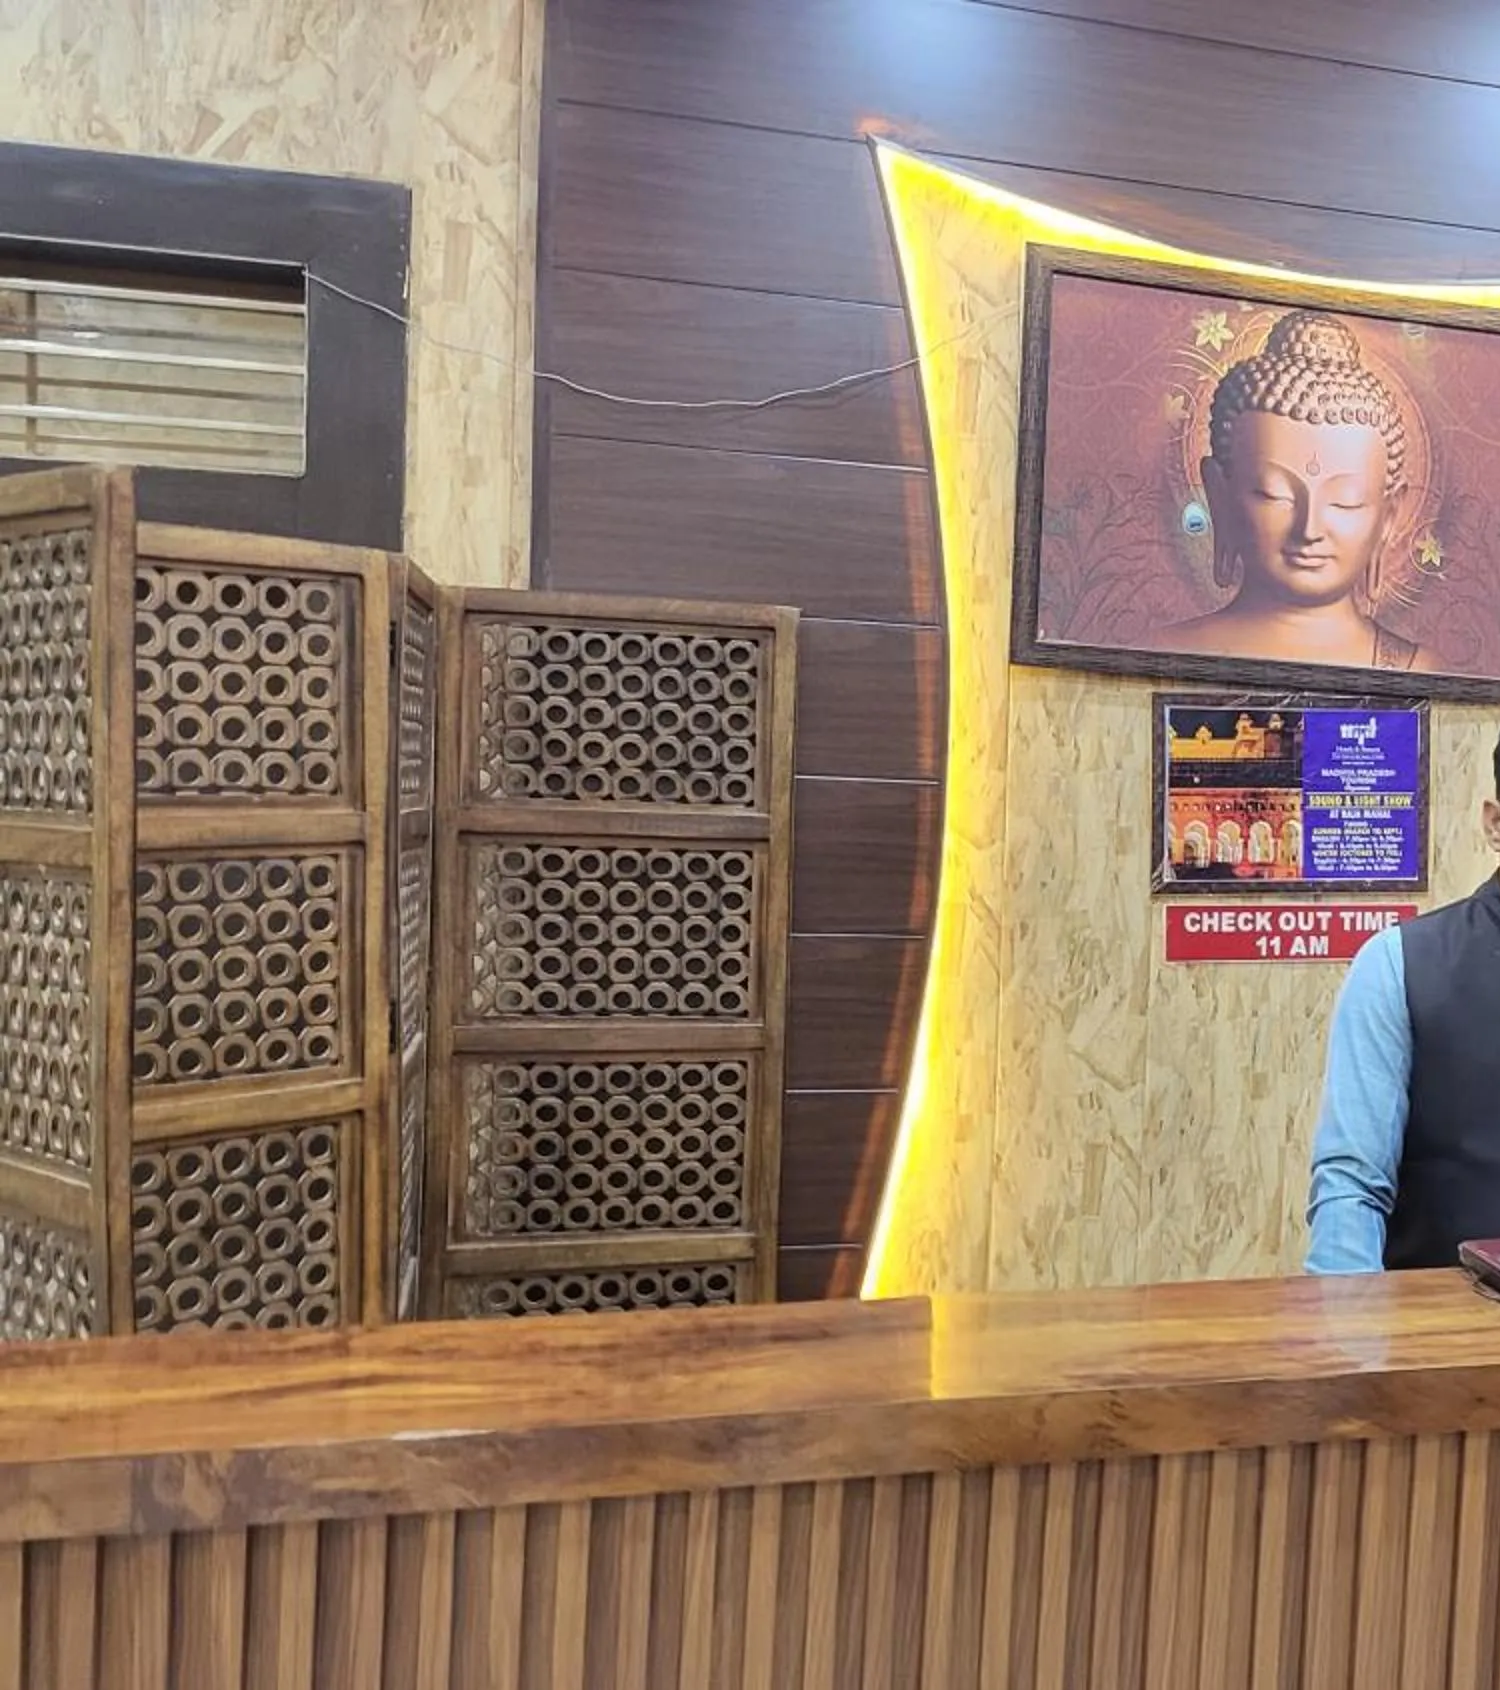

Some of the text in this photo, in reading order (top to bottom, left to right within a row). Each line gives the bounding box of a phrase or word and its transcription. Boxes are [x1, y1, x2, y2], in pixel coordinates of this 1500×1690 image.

[1309, 794, 1343, 807] SOUND
[1353, 794, 1381, 807] LIGHT
[1384, 794, 1412, 807] SHOW
[1183, 911, 1273, 932] CHECK
[1278, 911, 1333, 932] OUT
[1255, 935, 1329, 956] 11 AM
